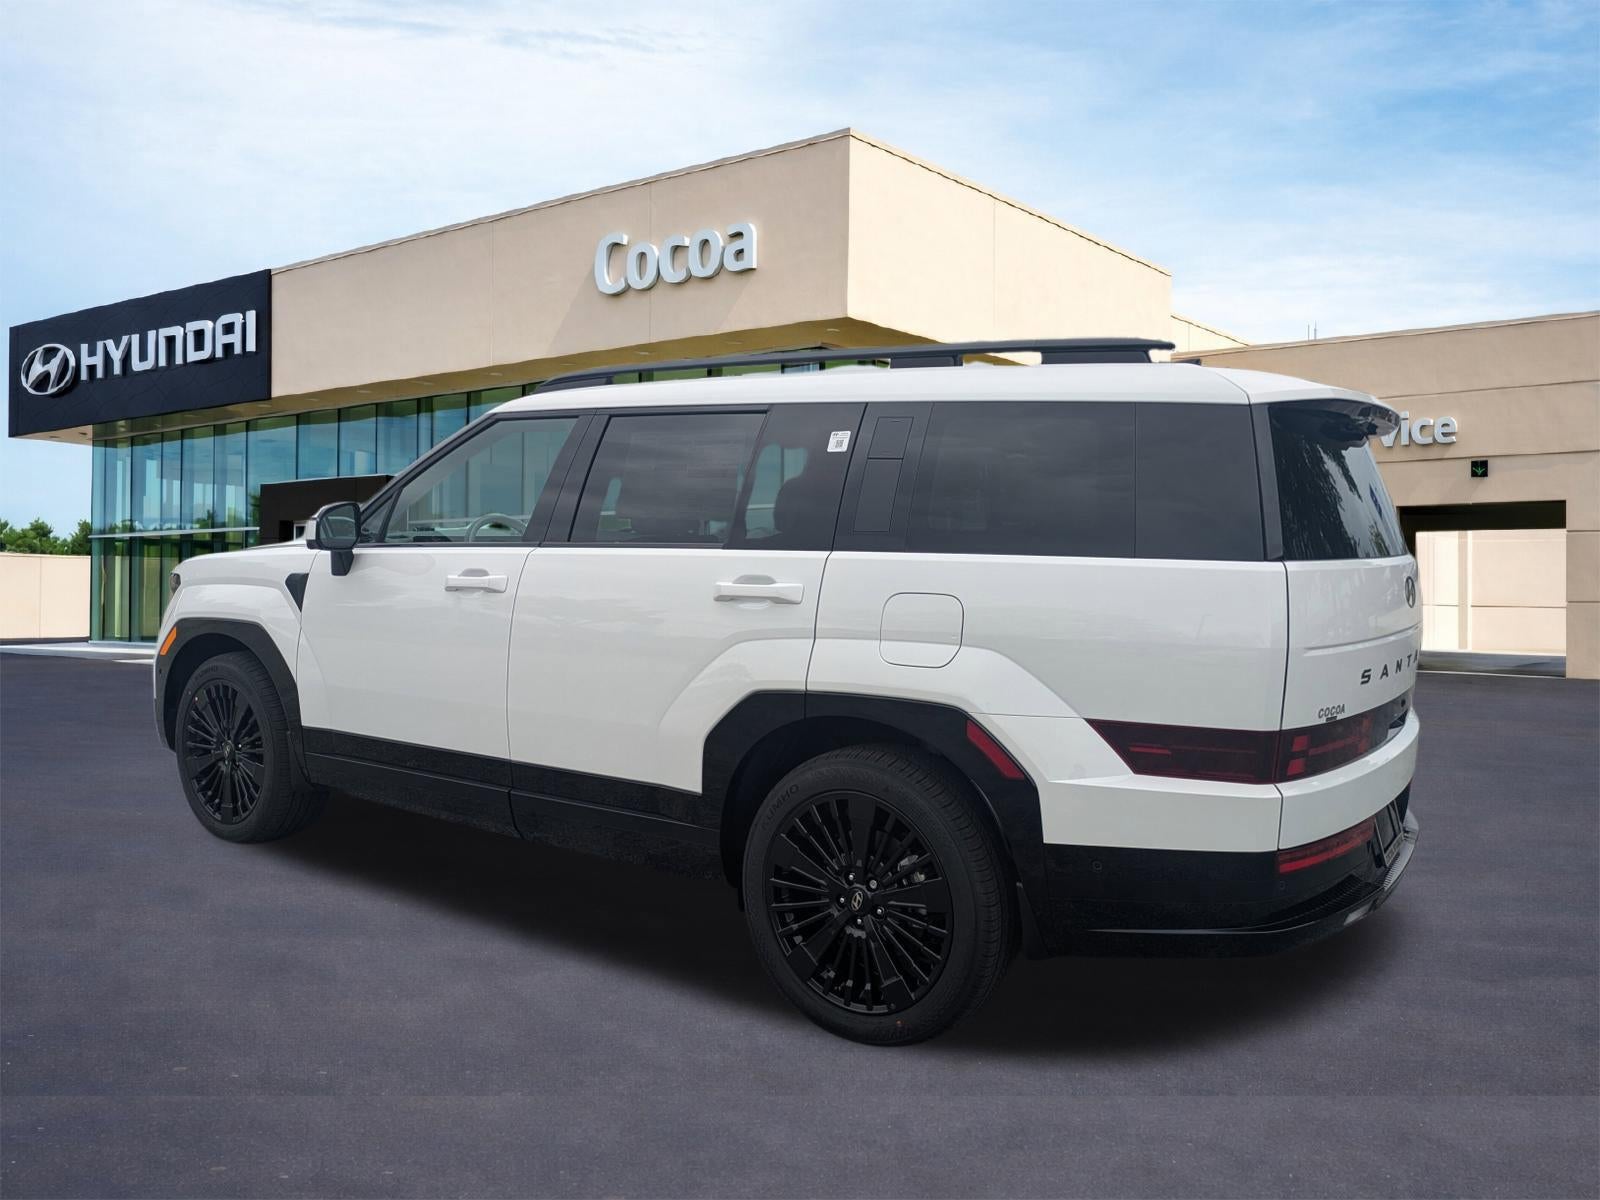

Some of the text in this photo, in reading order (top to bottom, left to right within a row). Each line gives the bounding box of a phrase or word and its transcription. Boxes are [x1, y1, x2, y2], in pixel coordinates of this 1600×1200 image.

[594, 222, 757, 295] Cocoa
[80, 310, 257, 381] HYUNDAI
[1318, 703, 1345, 719] COCOA
